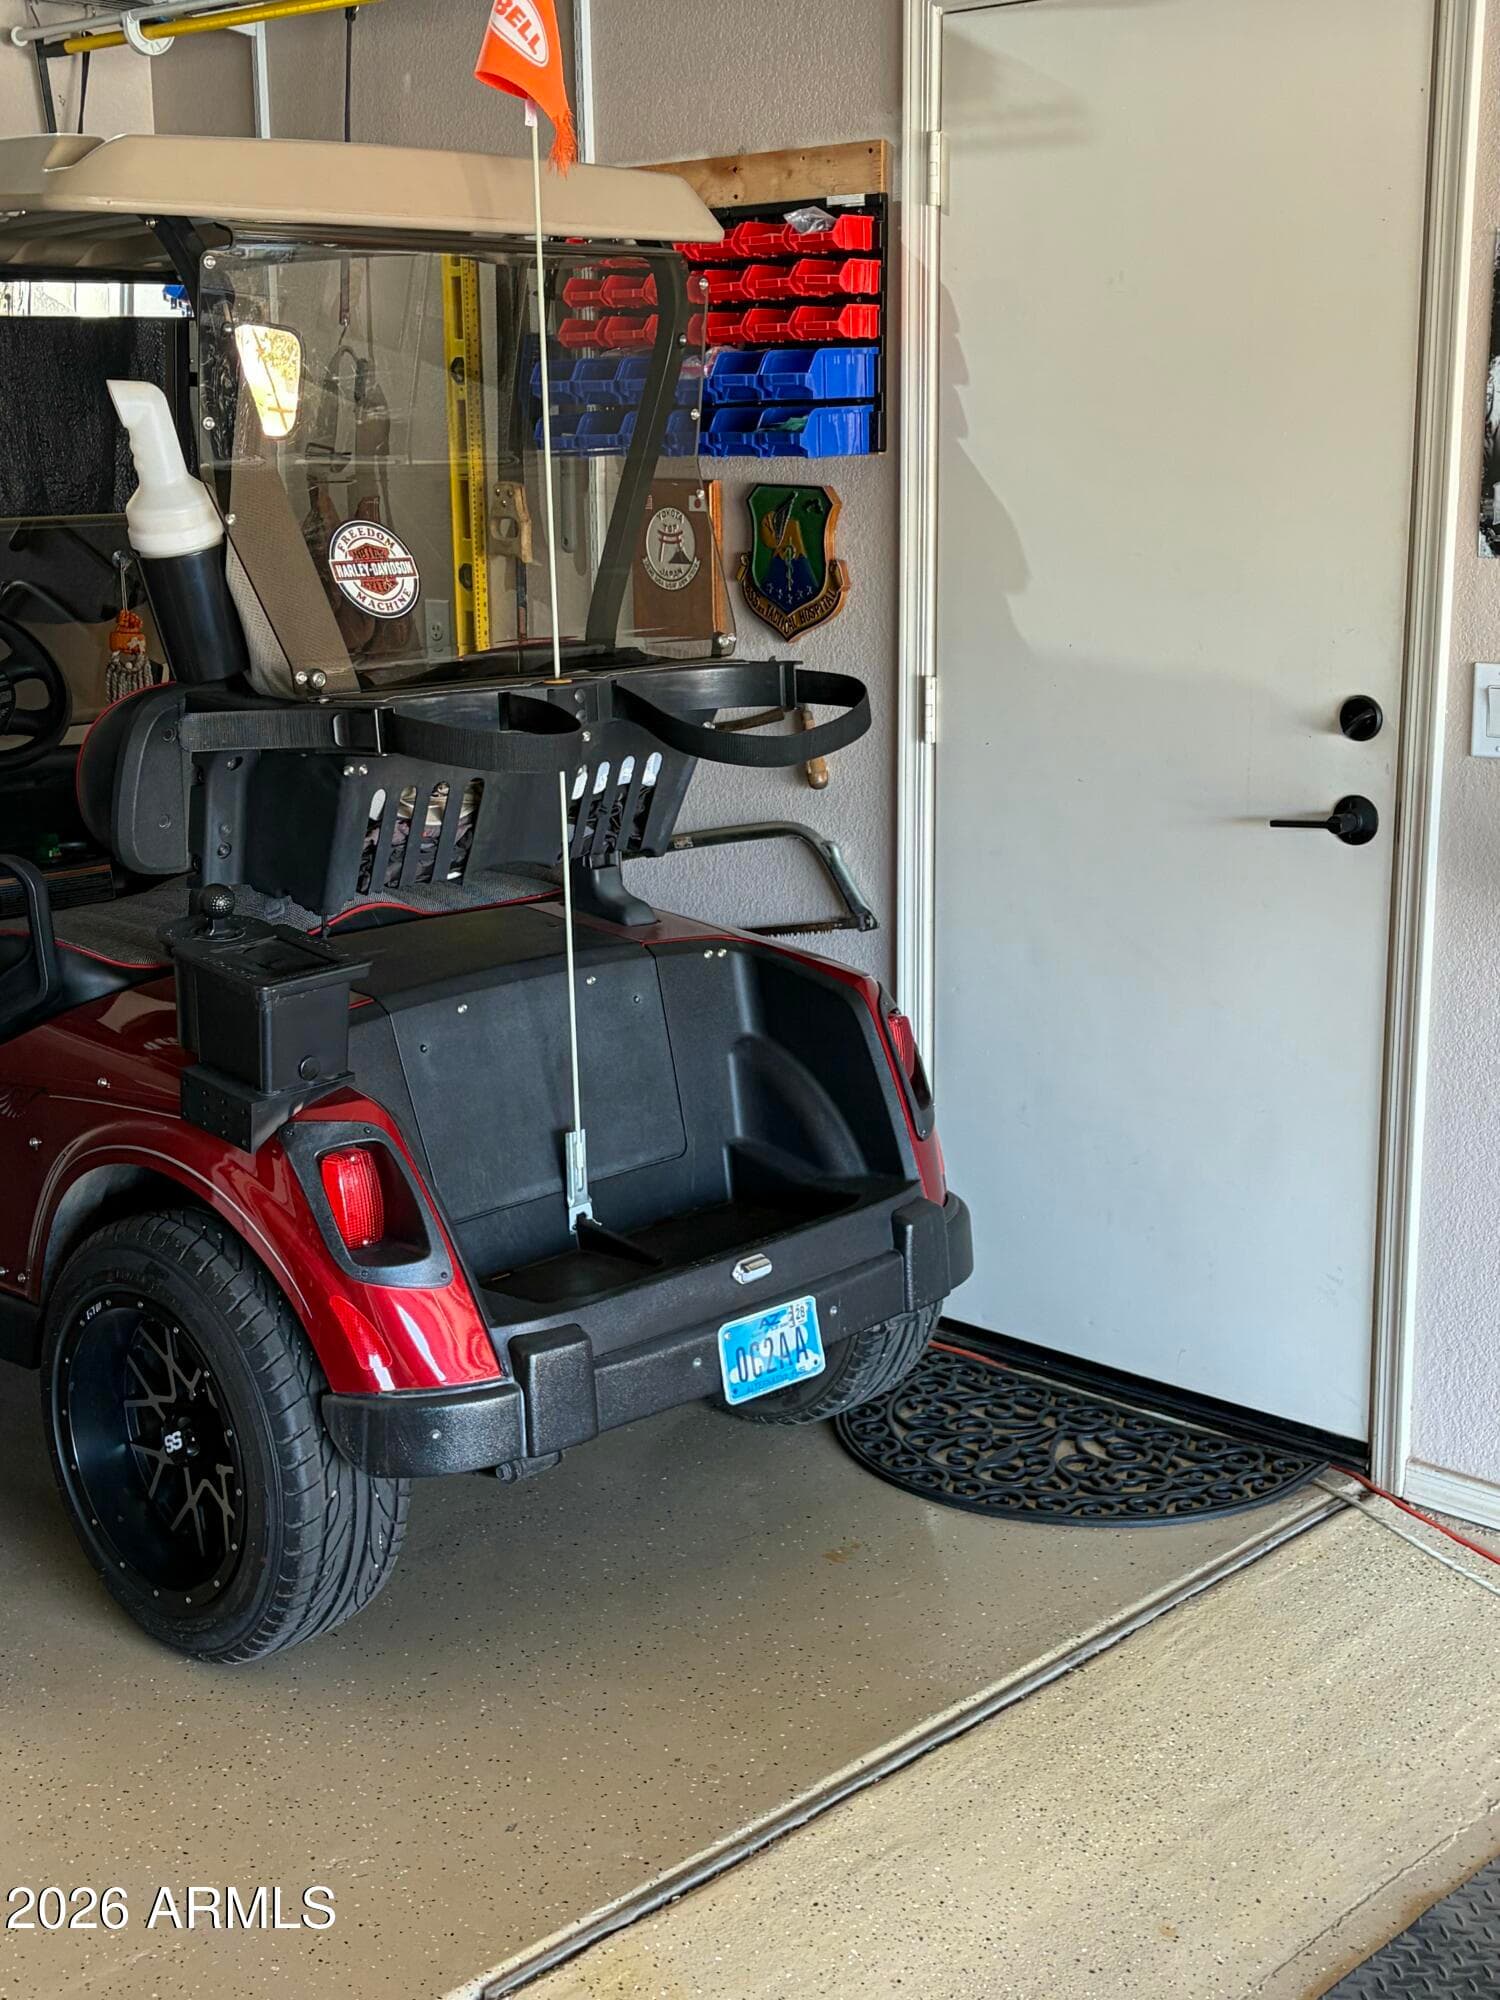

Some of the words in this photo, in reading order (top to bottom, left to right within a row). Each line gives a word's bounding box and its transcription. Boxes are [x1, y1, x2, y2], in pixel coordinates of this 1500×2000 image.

[495, 0, 540, 55] BELL
[337, 527, 396, 553] FREEDOM
[334, 561, 414, 577] HARLEY-DAVIDSON
[356, 588, 411, 611] MACHINE
[799, 587, 838, 624] HOSPITAL
[760, 1313, 781, 1327] AZ
